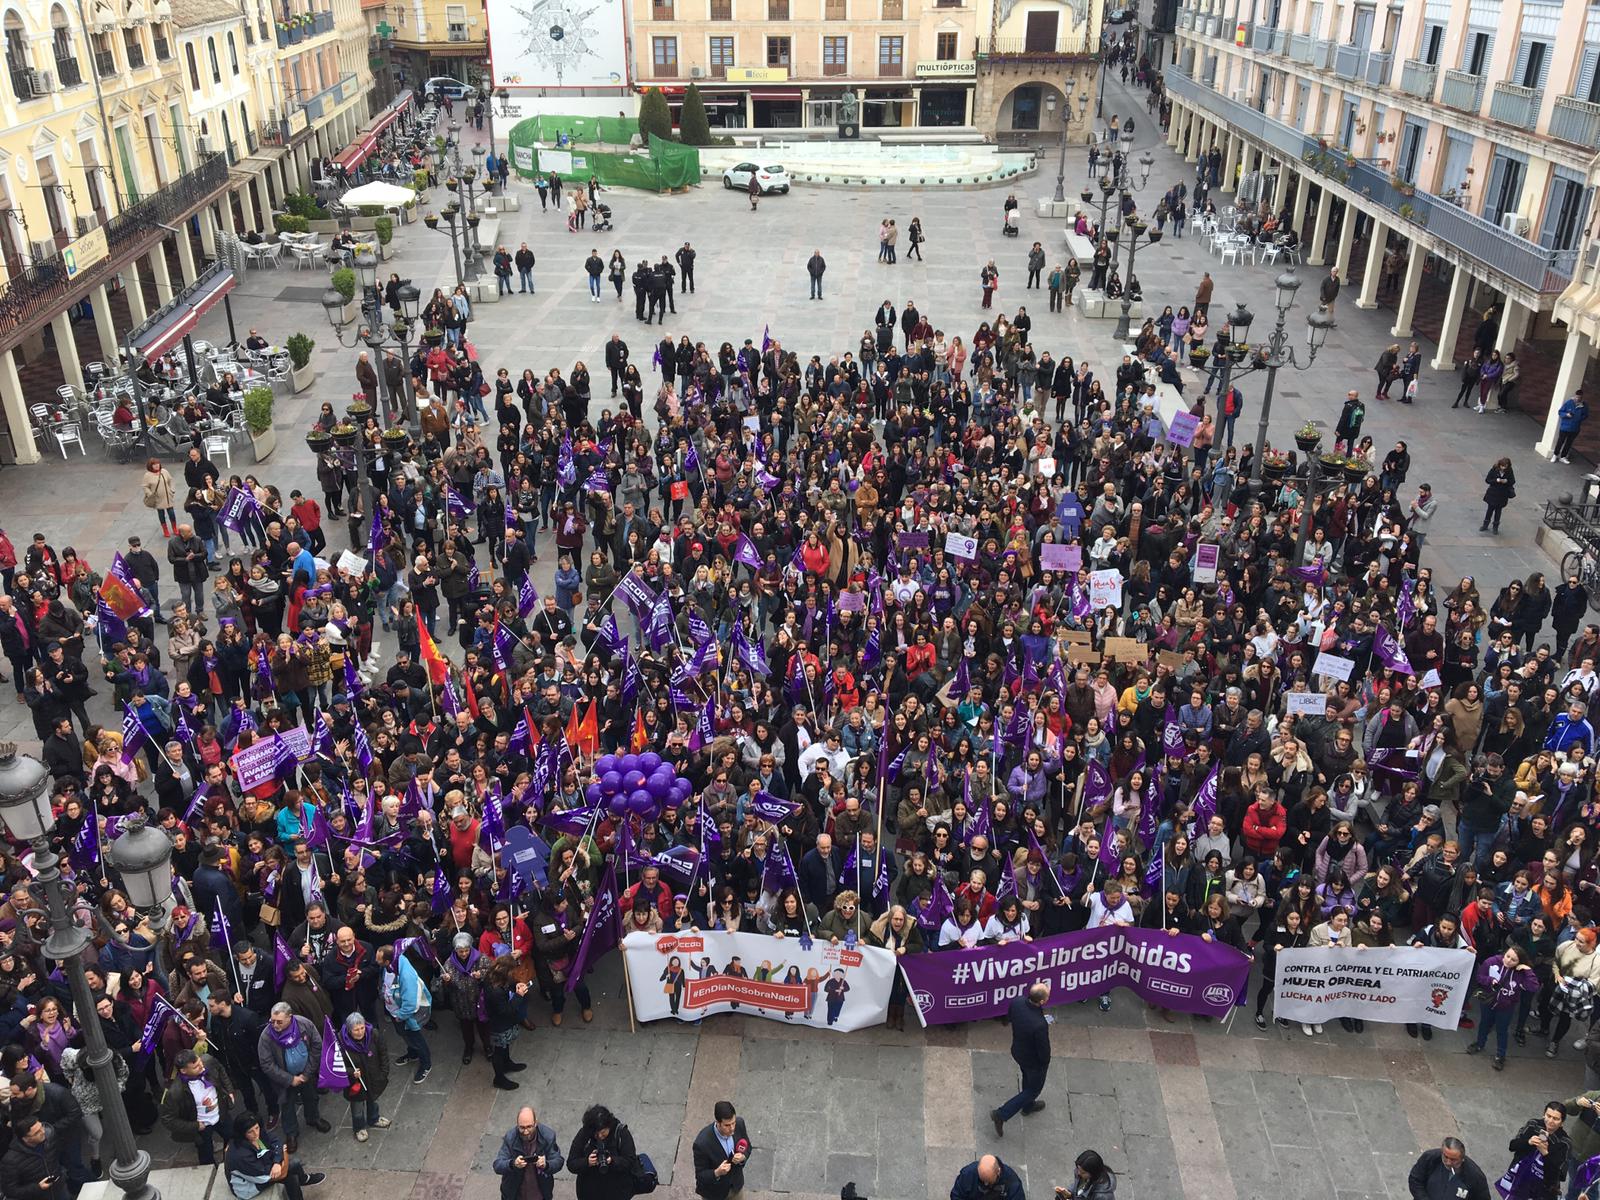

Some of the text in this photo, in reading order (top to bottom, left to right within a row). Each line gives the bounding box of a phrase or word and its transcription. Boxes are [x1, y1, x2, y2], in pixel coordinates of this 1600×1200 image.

[623, 578, 648, 605] CCOO
[239, 748, 275, 766] PARAMO
[952, 934, 1192, 985] #VivasLibresUnidas
[1284, 964, 1461, 980] CONTRA EL CAPITAL Y EL PATRIARCADO
[993, 982, 1027, 1005] por
[1060, 960, 1142, 991] igualdad
[1151, 981, 1189, 995] CCOO
[1282, 976, 1382, 989] MUJER OBRERA
[948, 994, 984, 1006] CCOO
[1207, 987, 1230, 998] UGT
[1280, 991, 1397, 1004] LUCHA A NUESTRO LADO
